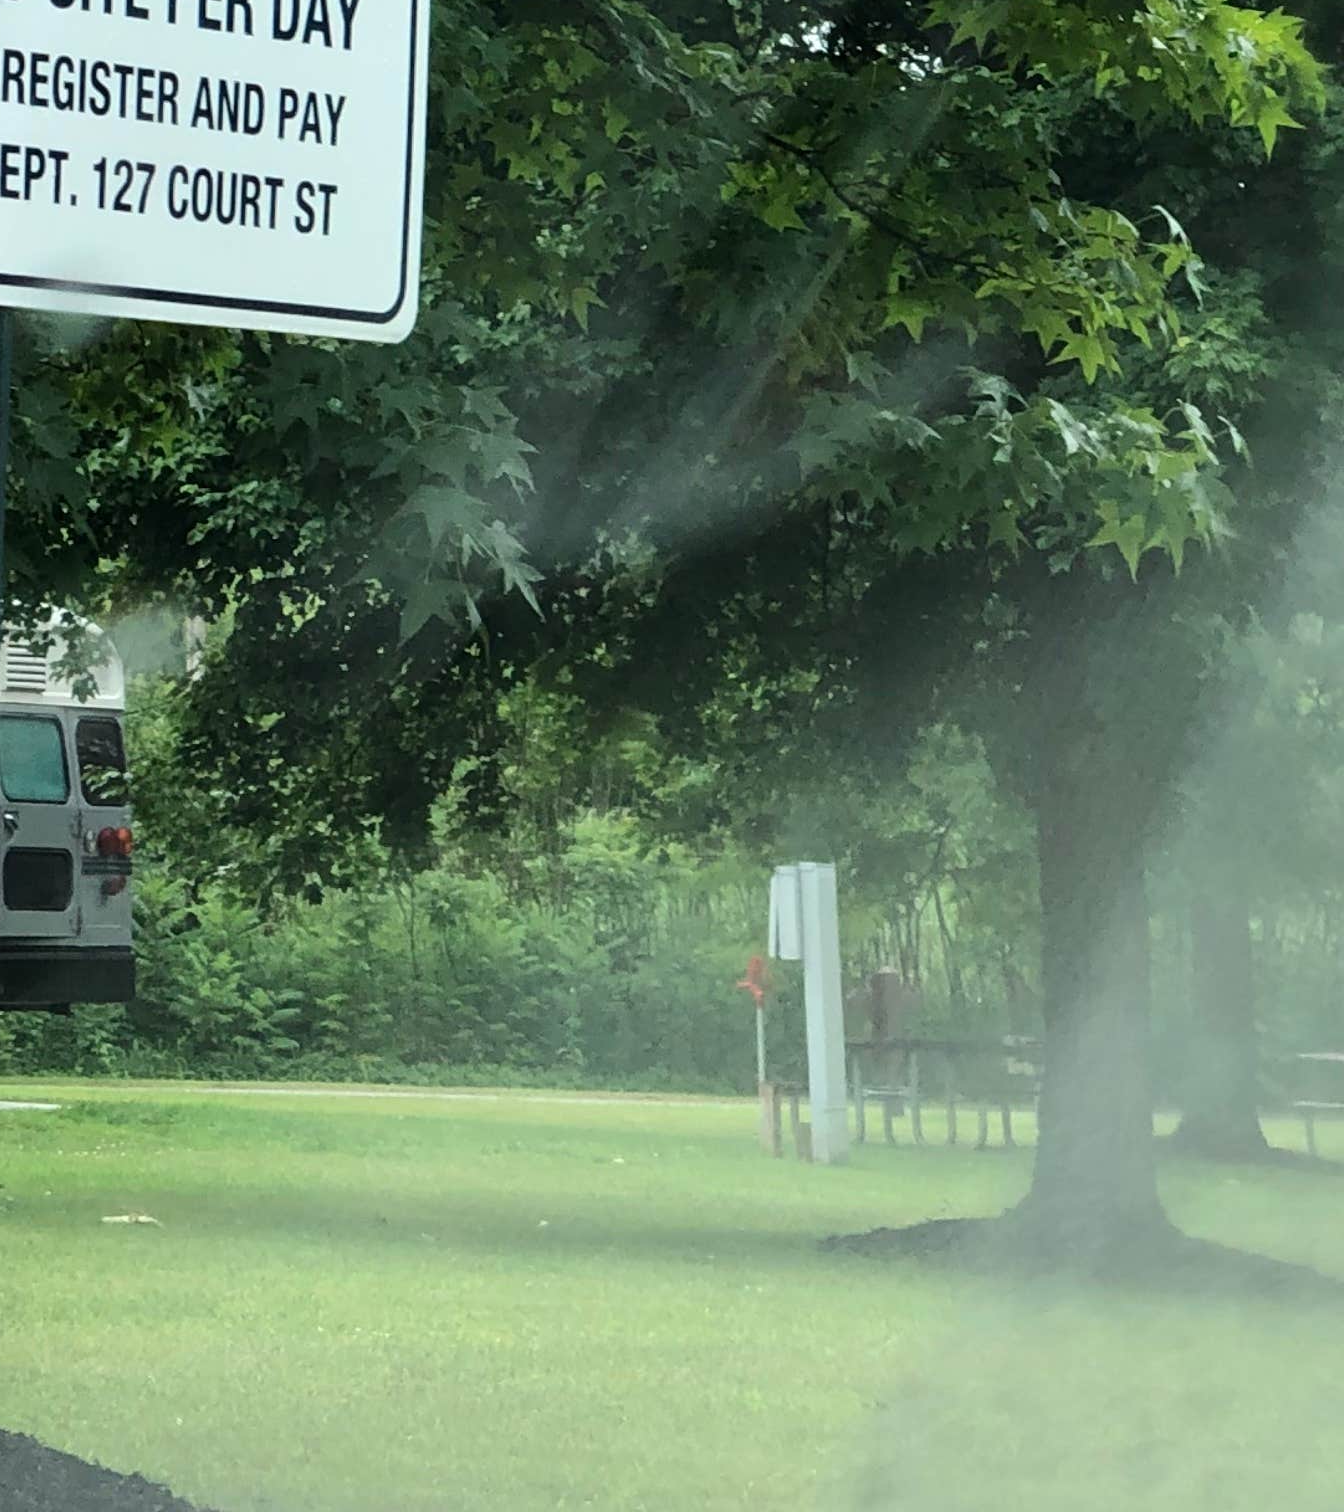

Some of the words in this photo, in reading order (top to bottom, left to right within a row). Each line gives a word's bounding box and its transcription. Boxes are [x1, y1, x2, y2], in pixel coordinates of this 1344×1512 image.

[1, 48, 179, 125] REGISTER
[191, 76, 265, 136] AND
[278, 87, 346, 146] PAY
[93, 157, 156, 214] 127
[168, 165, 284, 229] COURT
[294, 181, 338, 236] ST
